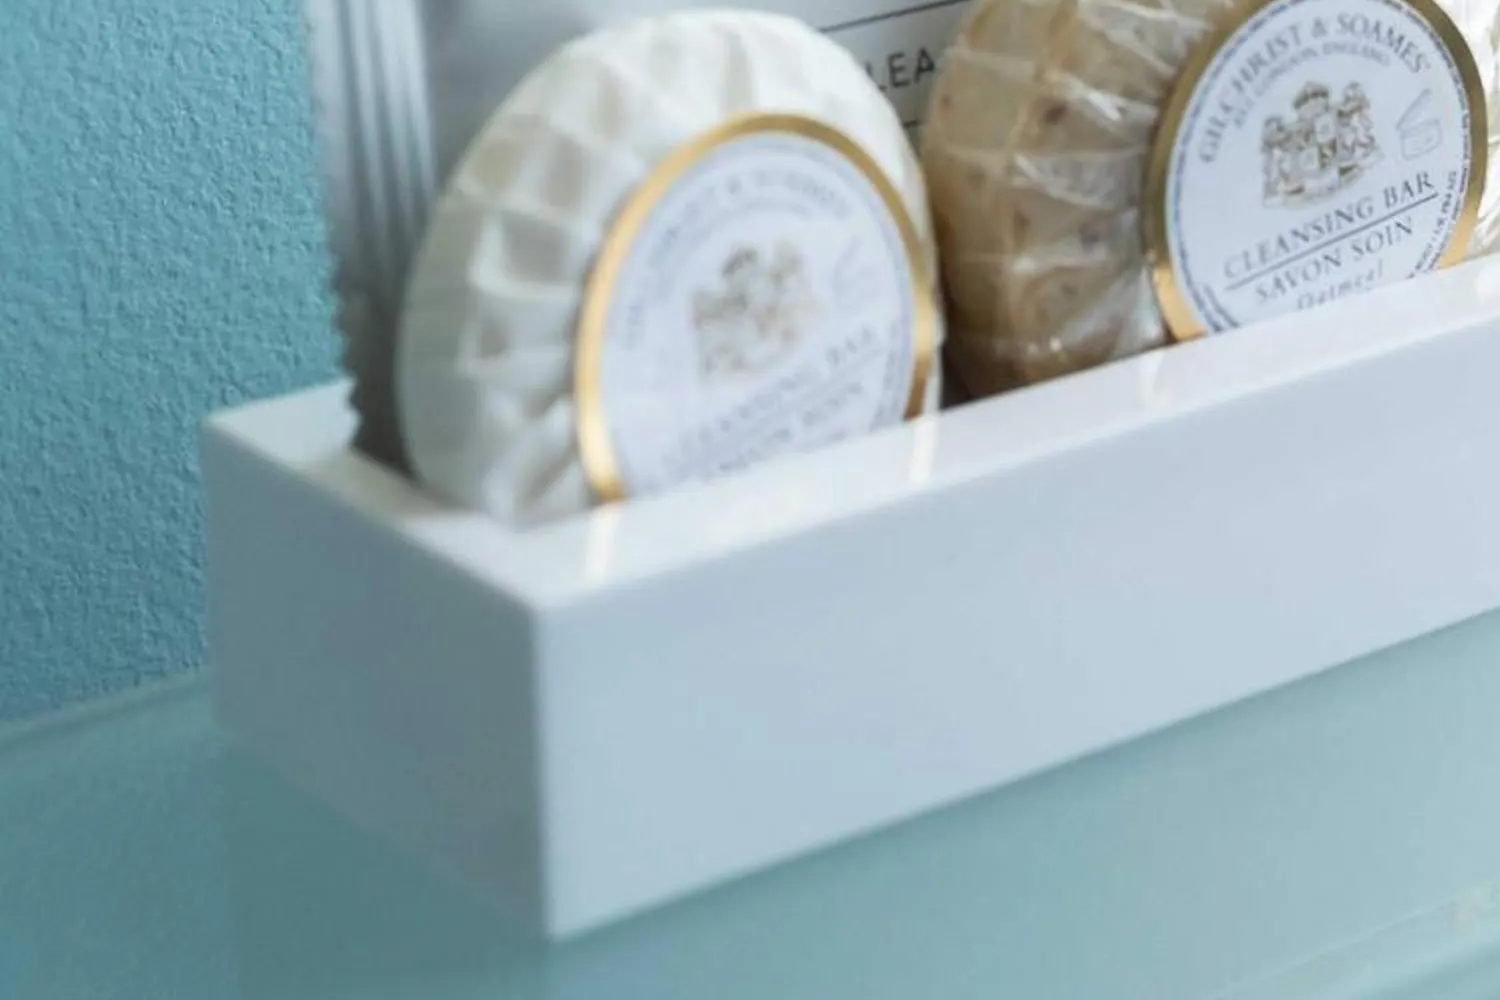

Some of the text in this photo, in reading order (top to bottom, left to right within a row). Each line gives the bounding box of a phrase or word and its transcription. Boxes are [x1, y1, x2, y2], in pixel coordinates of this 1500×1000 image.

[1222, 196, 1375, 280] CLEANSING
[1383, 171, 1435, 210] BAR
[1255, 245, 1342, 305] SAVON
[1350, 216, 1414, 262] SOIN
